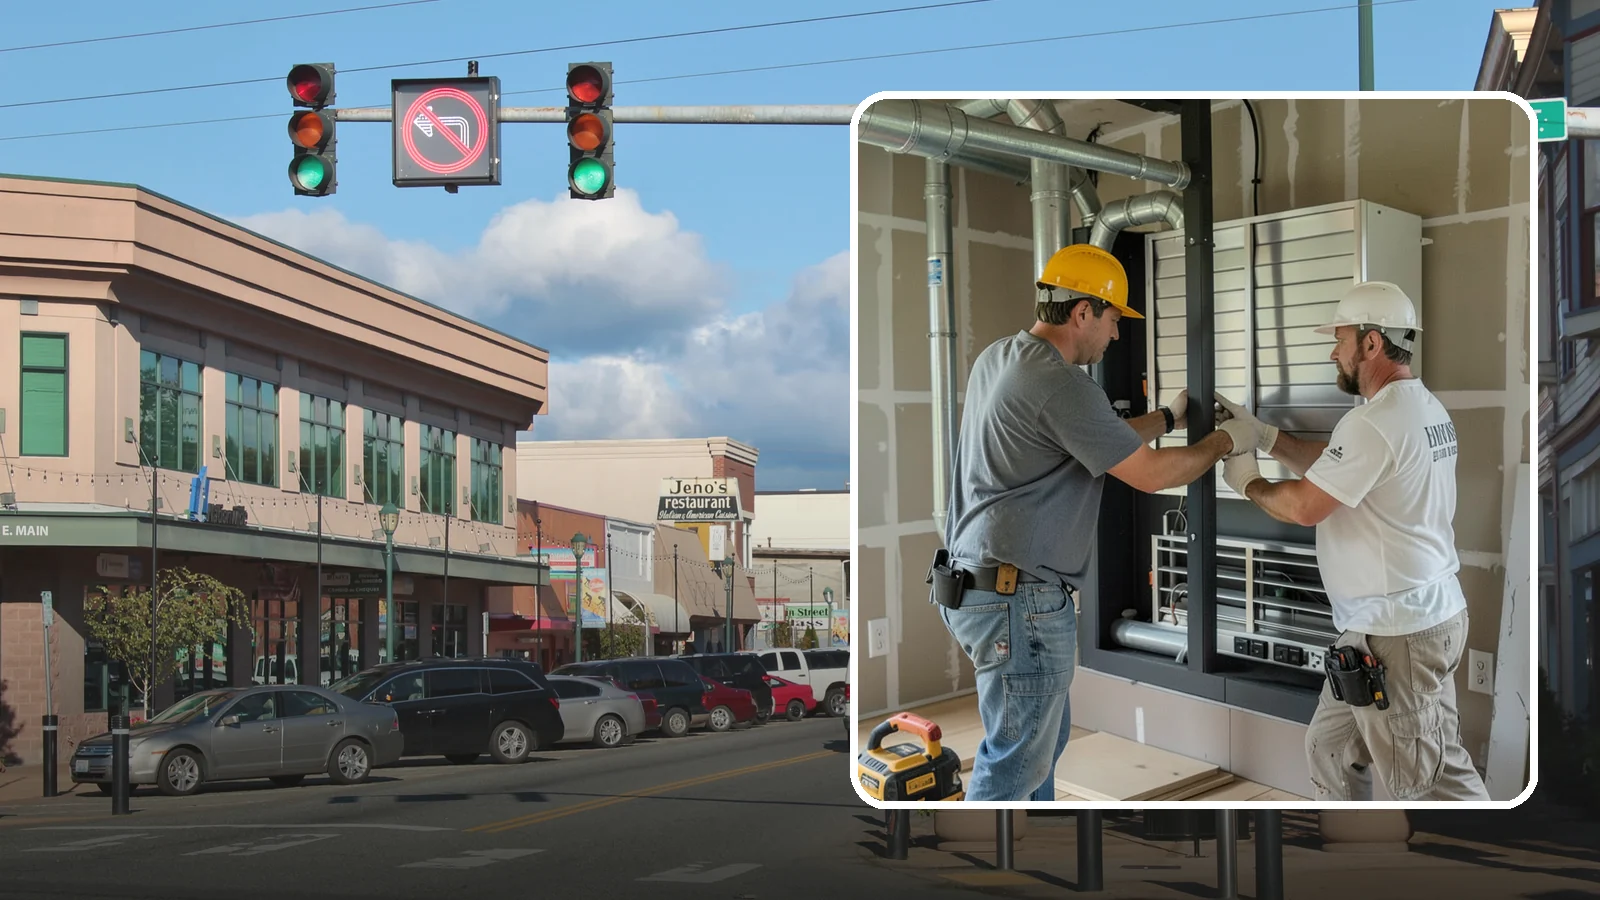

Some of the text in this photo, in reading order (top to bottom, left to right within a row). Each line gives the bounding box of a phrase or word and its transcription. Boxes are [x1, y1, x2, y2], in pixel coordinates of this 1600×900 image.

[670, 480, 727, 494] Jeno's
[665, 497, 731, 509] restaurant
[659, 510, 681, 519] Italian
[686, 510, 714, 519] American
[715, 510, 737, 519] Cuisine
[2, 525, 49, 536] E. MAIN
[797, 607, 829, 617] Street
